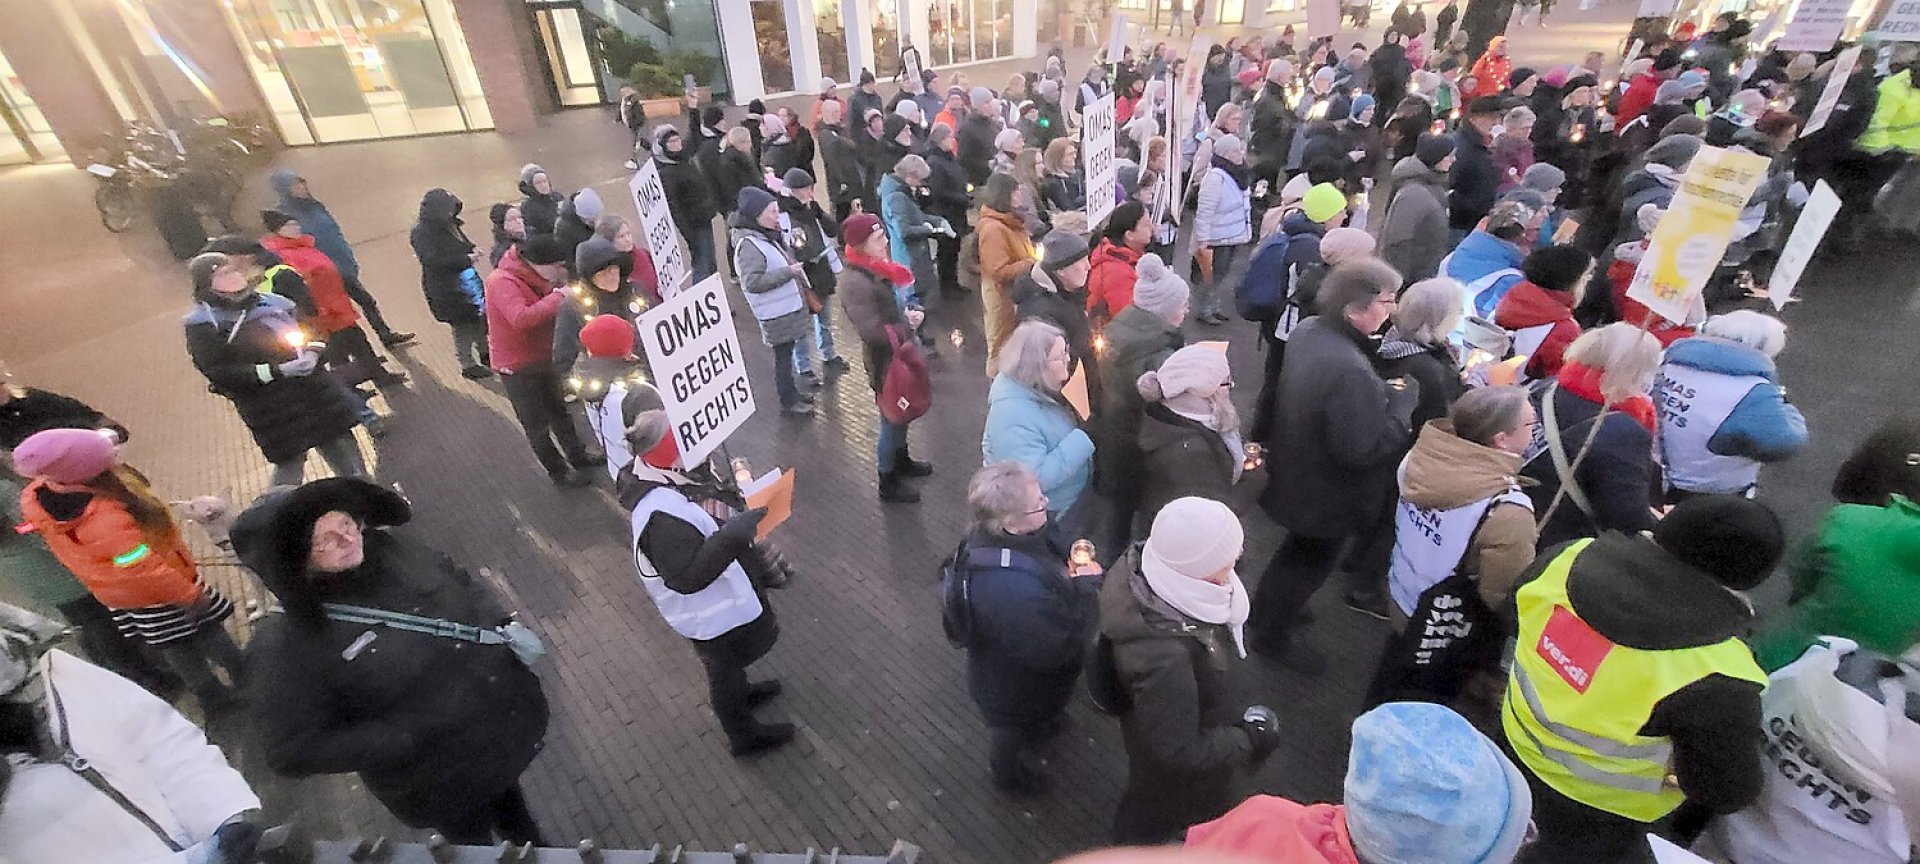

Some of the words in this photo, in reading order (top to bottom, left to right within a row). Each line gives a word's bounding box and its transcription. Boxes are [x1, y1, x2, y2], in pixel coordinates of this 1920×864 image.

[1089, 105, 1112, 142] OMAS
[637, 173, 661, 218] OMAS
[655, 291, 722, 357] OMAS
[671, 338, 734, 403] GEGEN
[1658, 373, 1697, 399] MAS
[678, 376, 749, 453] RECHTS
[1405, 504, 1442, 546] CHTS
[1543, 635, 1588, 687] ver.di
